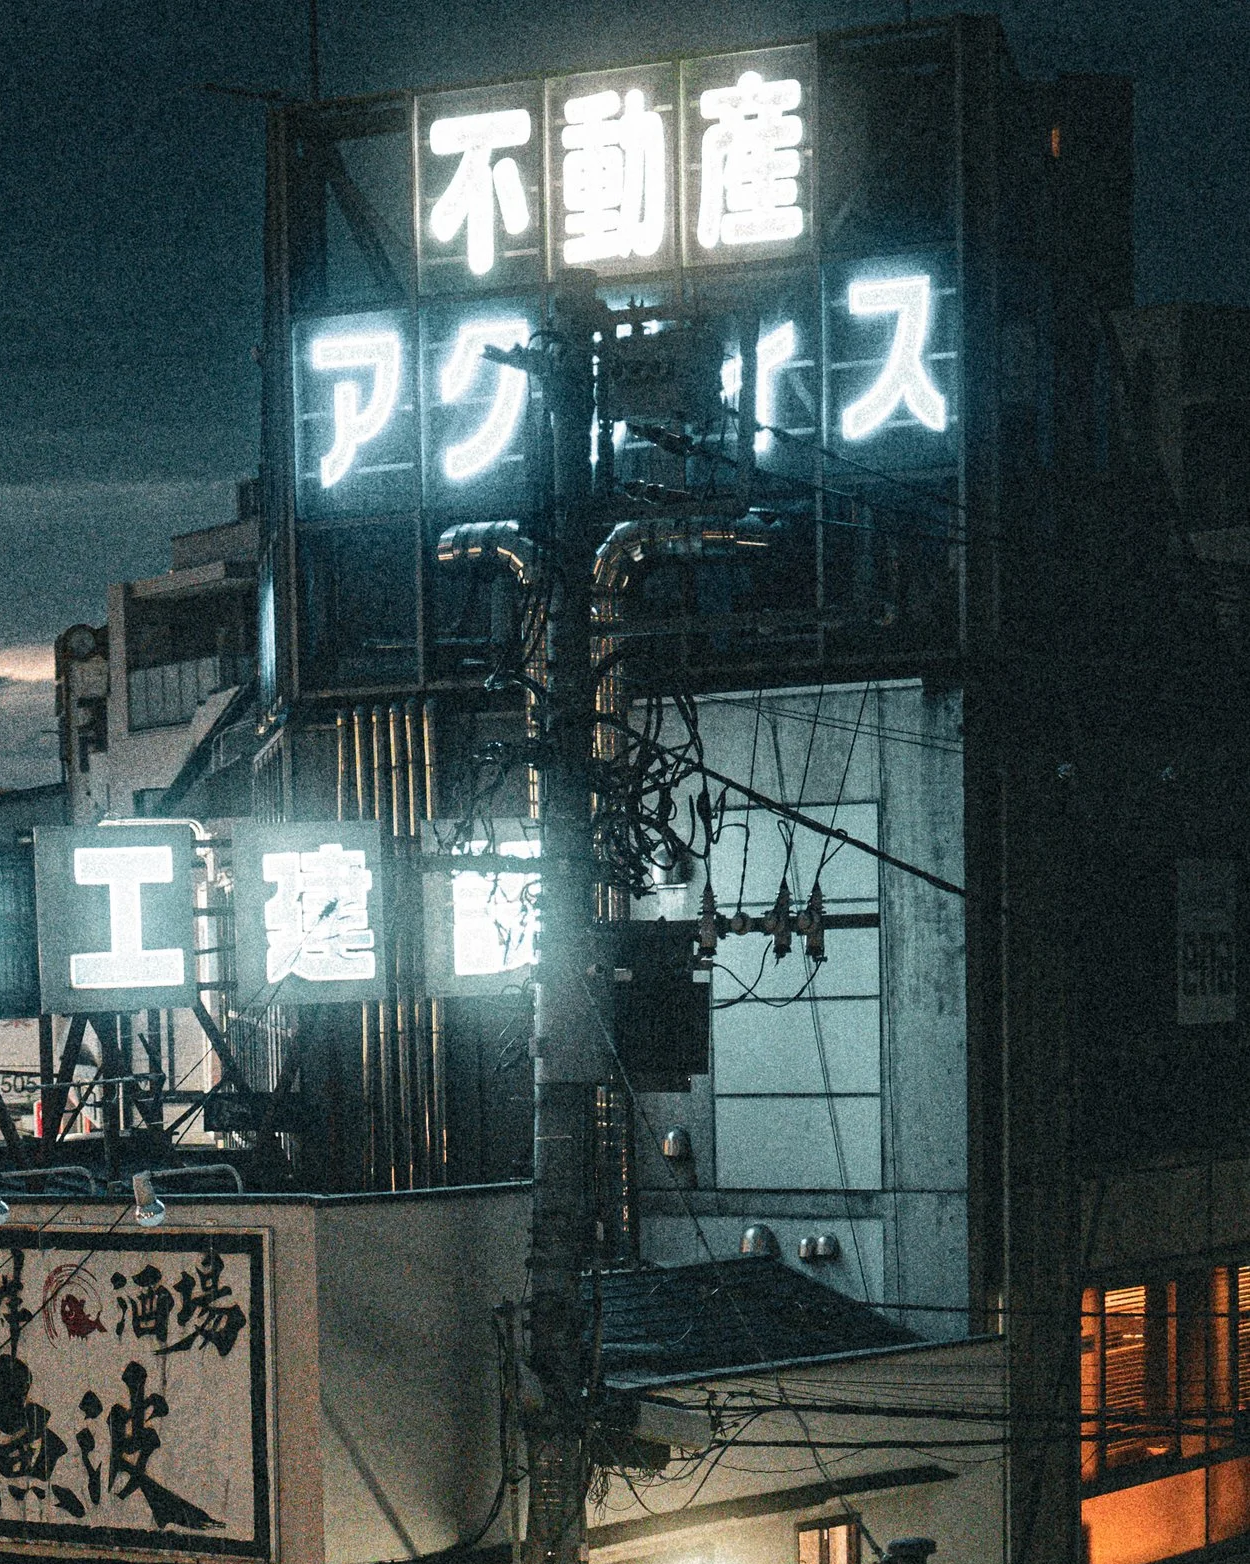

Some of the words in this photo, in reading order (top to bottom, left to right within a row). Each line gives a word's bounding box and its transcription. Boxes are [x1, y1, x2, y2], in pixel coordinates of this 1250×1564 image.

[429, 70, 804, 275] 不動産
[312, 274, 946, 489] アクィス
[110, 1251, 247, 1356] 酒場
